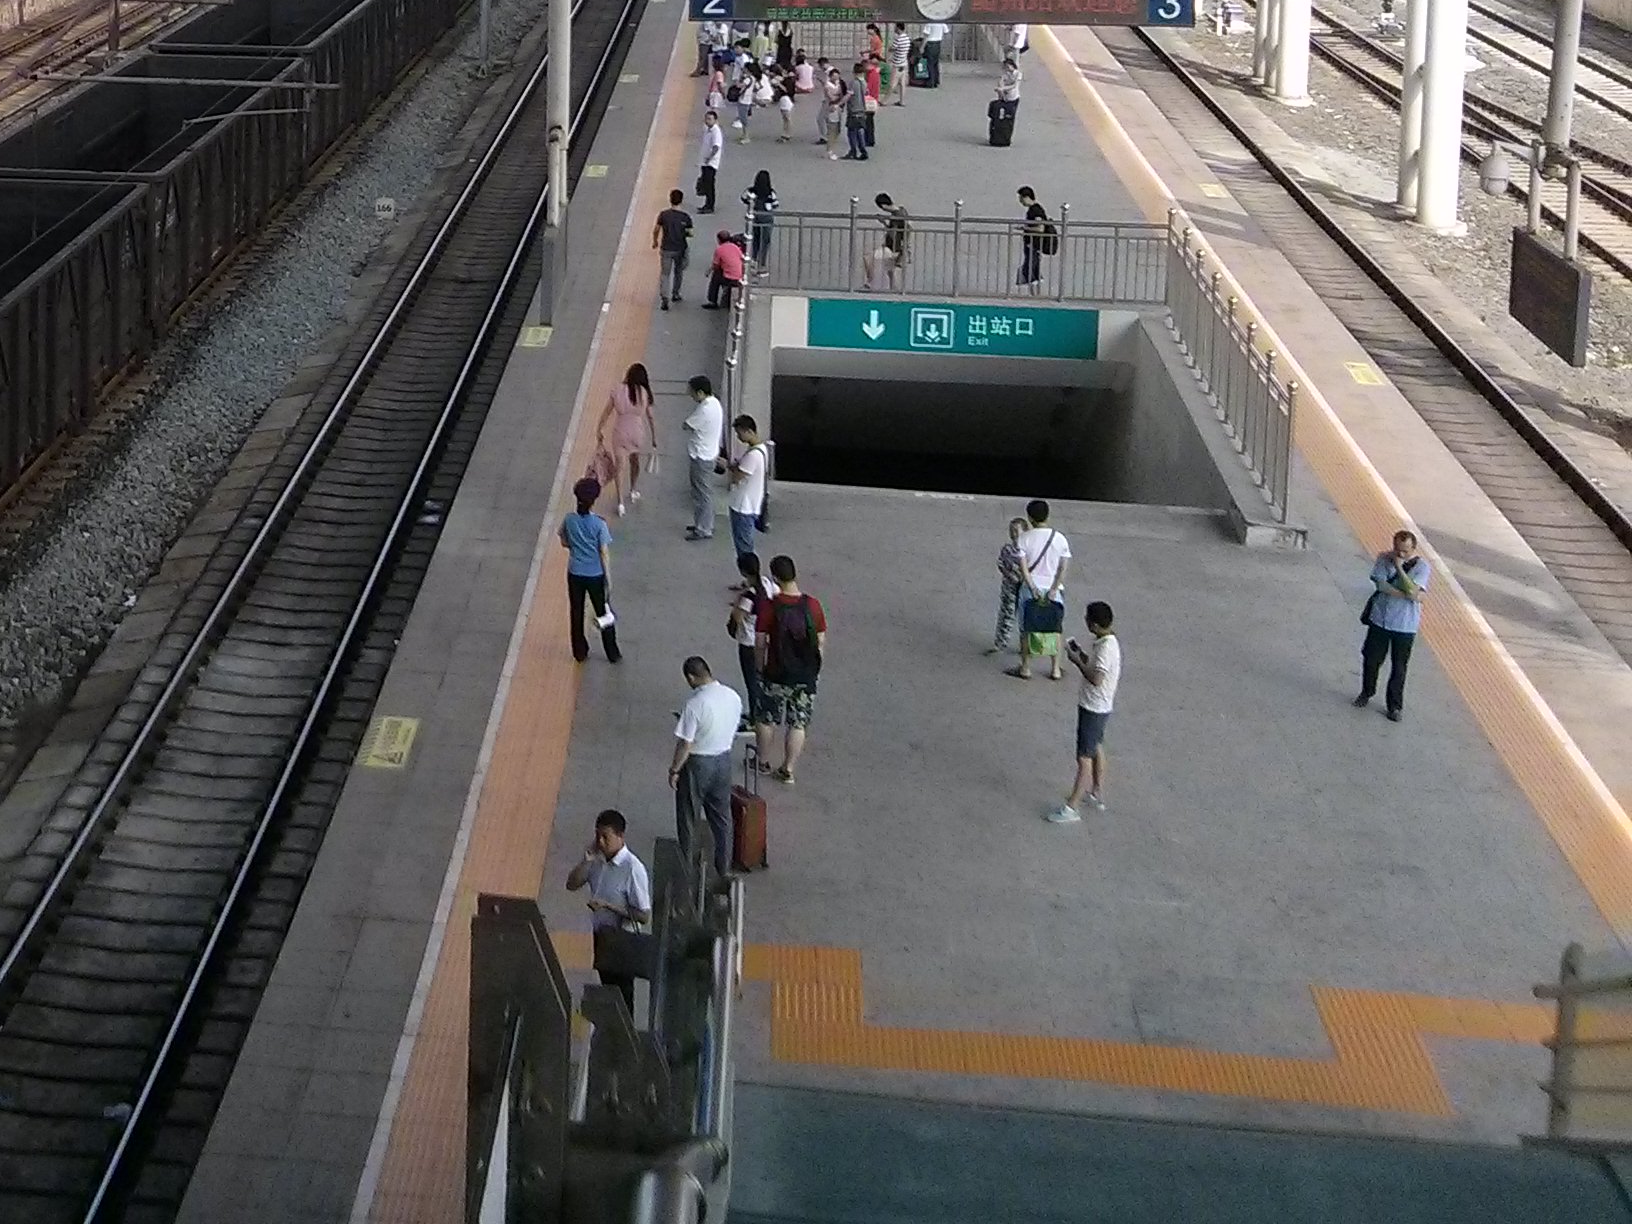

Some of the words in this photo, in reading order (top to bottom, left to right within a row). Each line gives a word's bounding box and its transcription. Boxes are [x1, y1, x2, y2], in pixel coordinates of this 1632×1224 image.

[968, 314, 1034, 336] 出站口
[968, 336, 989, 346] Exit
